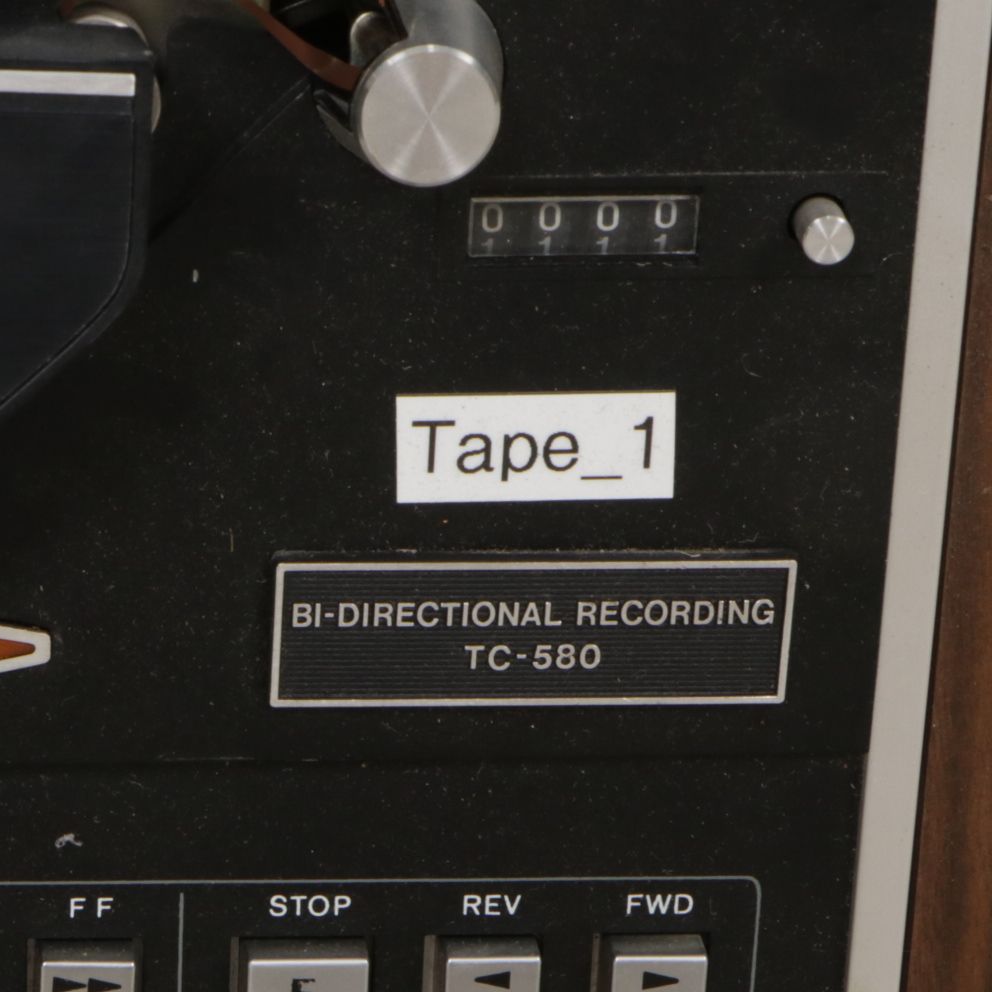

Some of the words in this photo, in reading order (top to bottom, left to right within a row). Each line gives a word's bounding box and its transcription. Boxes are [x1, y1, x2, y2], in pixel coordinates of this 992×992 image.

[411, 416, 656, 481] Tape_1
[291, 601, 562, 628] BI-DIRECTIONAL
[576, 599, 776, 626] RECORDING
[464, 643, 602, 671] TC-580
[268, 895, 352, 918] STOP
[462, 895, 522, 916] REV
[626, 894, 694, 915] FWD
